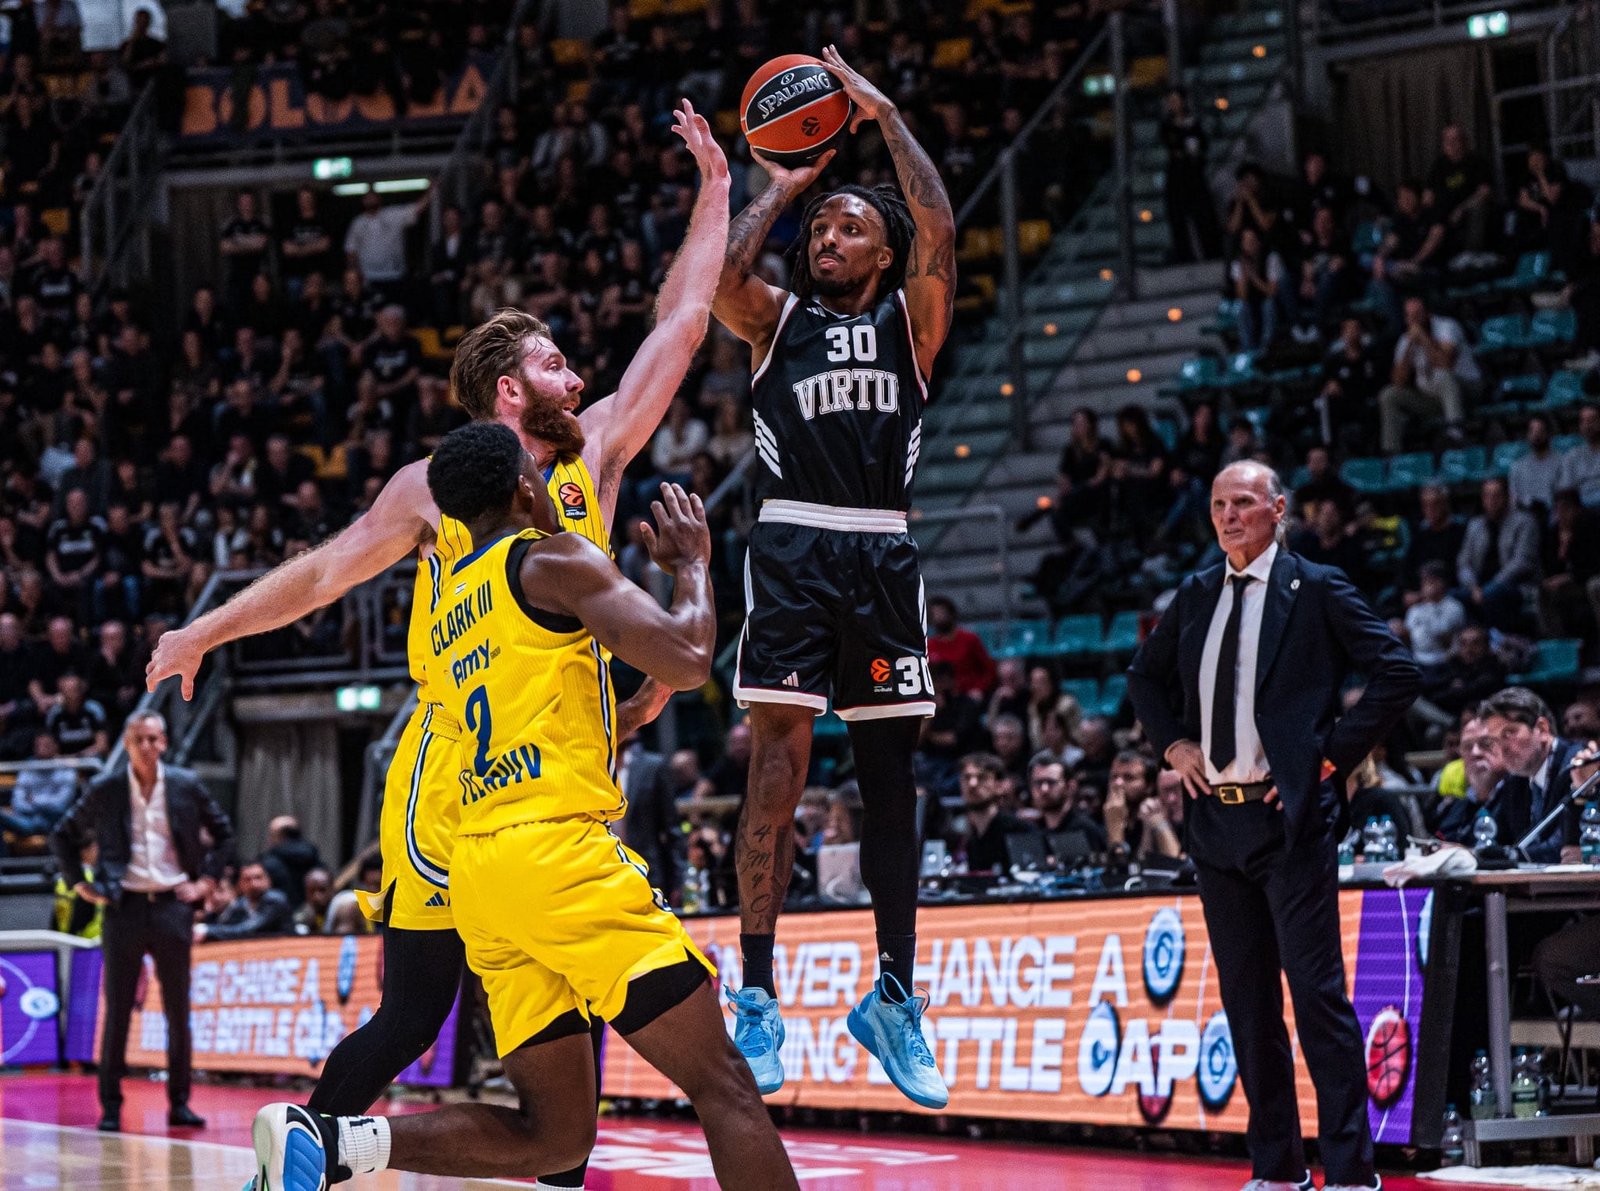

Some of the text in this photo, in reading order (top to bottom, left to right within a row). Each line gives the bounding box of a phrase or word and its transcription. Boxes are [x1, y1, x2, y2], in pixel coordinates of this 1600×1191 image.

[757, 72, 832, 119] SPALDING
[825, 325, 877, 362] 30
[793, 368, 901, 421] VIRTU
[431, 579, 493, 657] CLARK III
[465, 684, 498, 777] 2
[718, 933, 1129, 1008] NVER HANGE A
[867, 1016, 1066, 1093] TTLE
[1077, 1018, 1201, 1097] CAP
